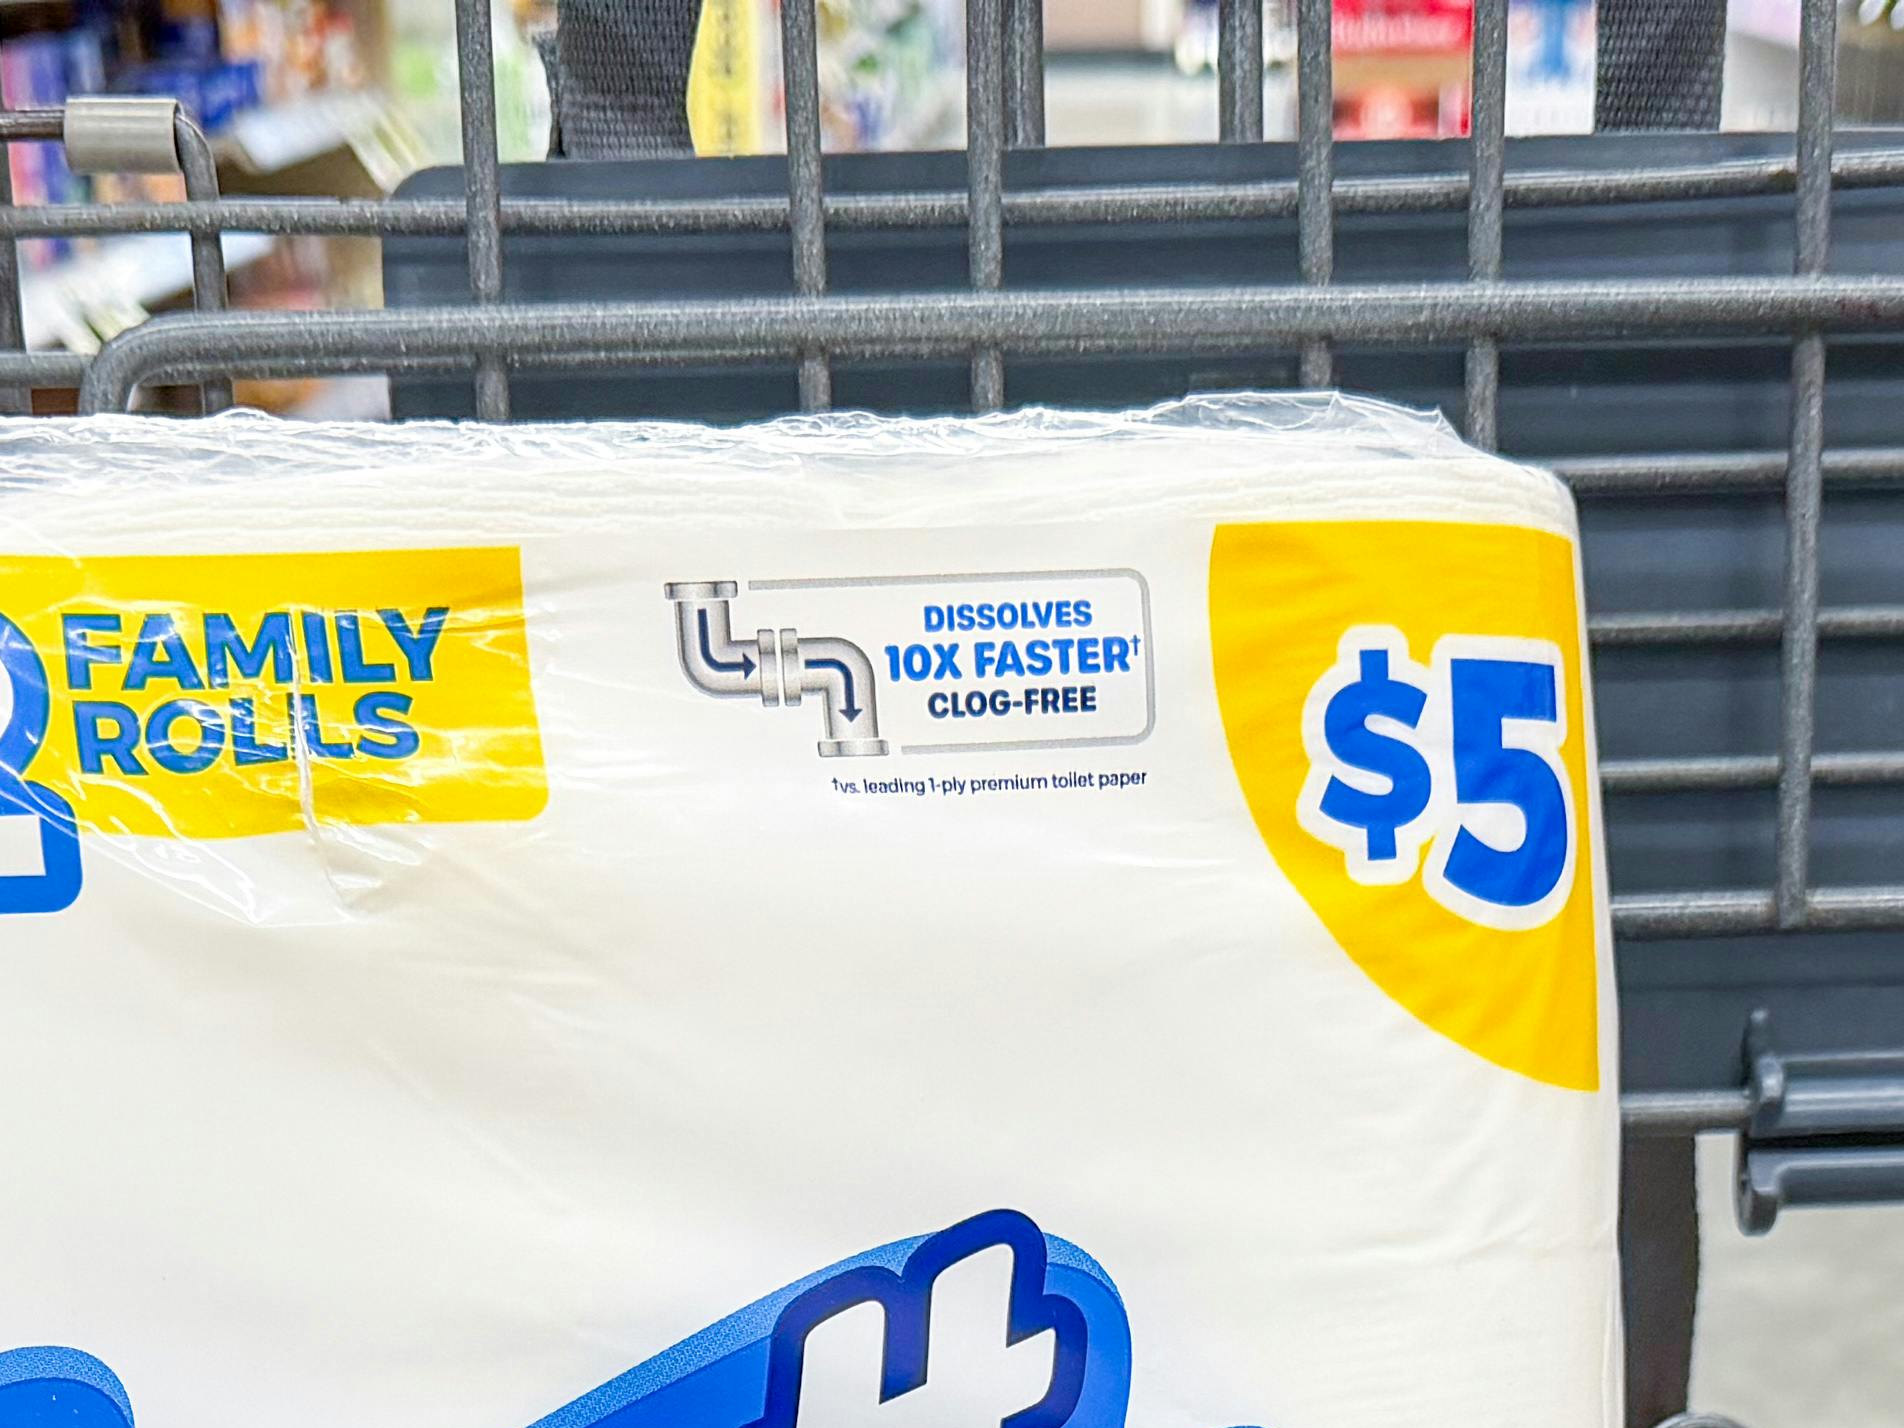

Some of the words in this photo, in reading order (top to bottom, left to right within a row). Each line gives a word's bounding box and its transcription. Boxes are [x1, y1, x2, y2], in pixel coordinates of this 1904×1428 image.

[923, 600, 1093, 632] DISSOLVES
[65, 605, 451, 690] FAMILY
[884, 643, 961, 682] 10X
[928, 685, 1097, 719] CLOG-FREE
[75, 691, 422, 775] ROLLS
[863, 777, 925, 795] leading
[929, 775, 966, 796] 1-ply
[970, 774, 1048, 795] premium
[1052, 773, 1095, 789] toilet
[1098, 771, 1147, 790] paper
[1319, 649, 1569, 907] $5
